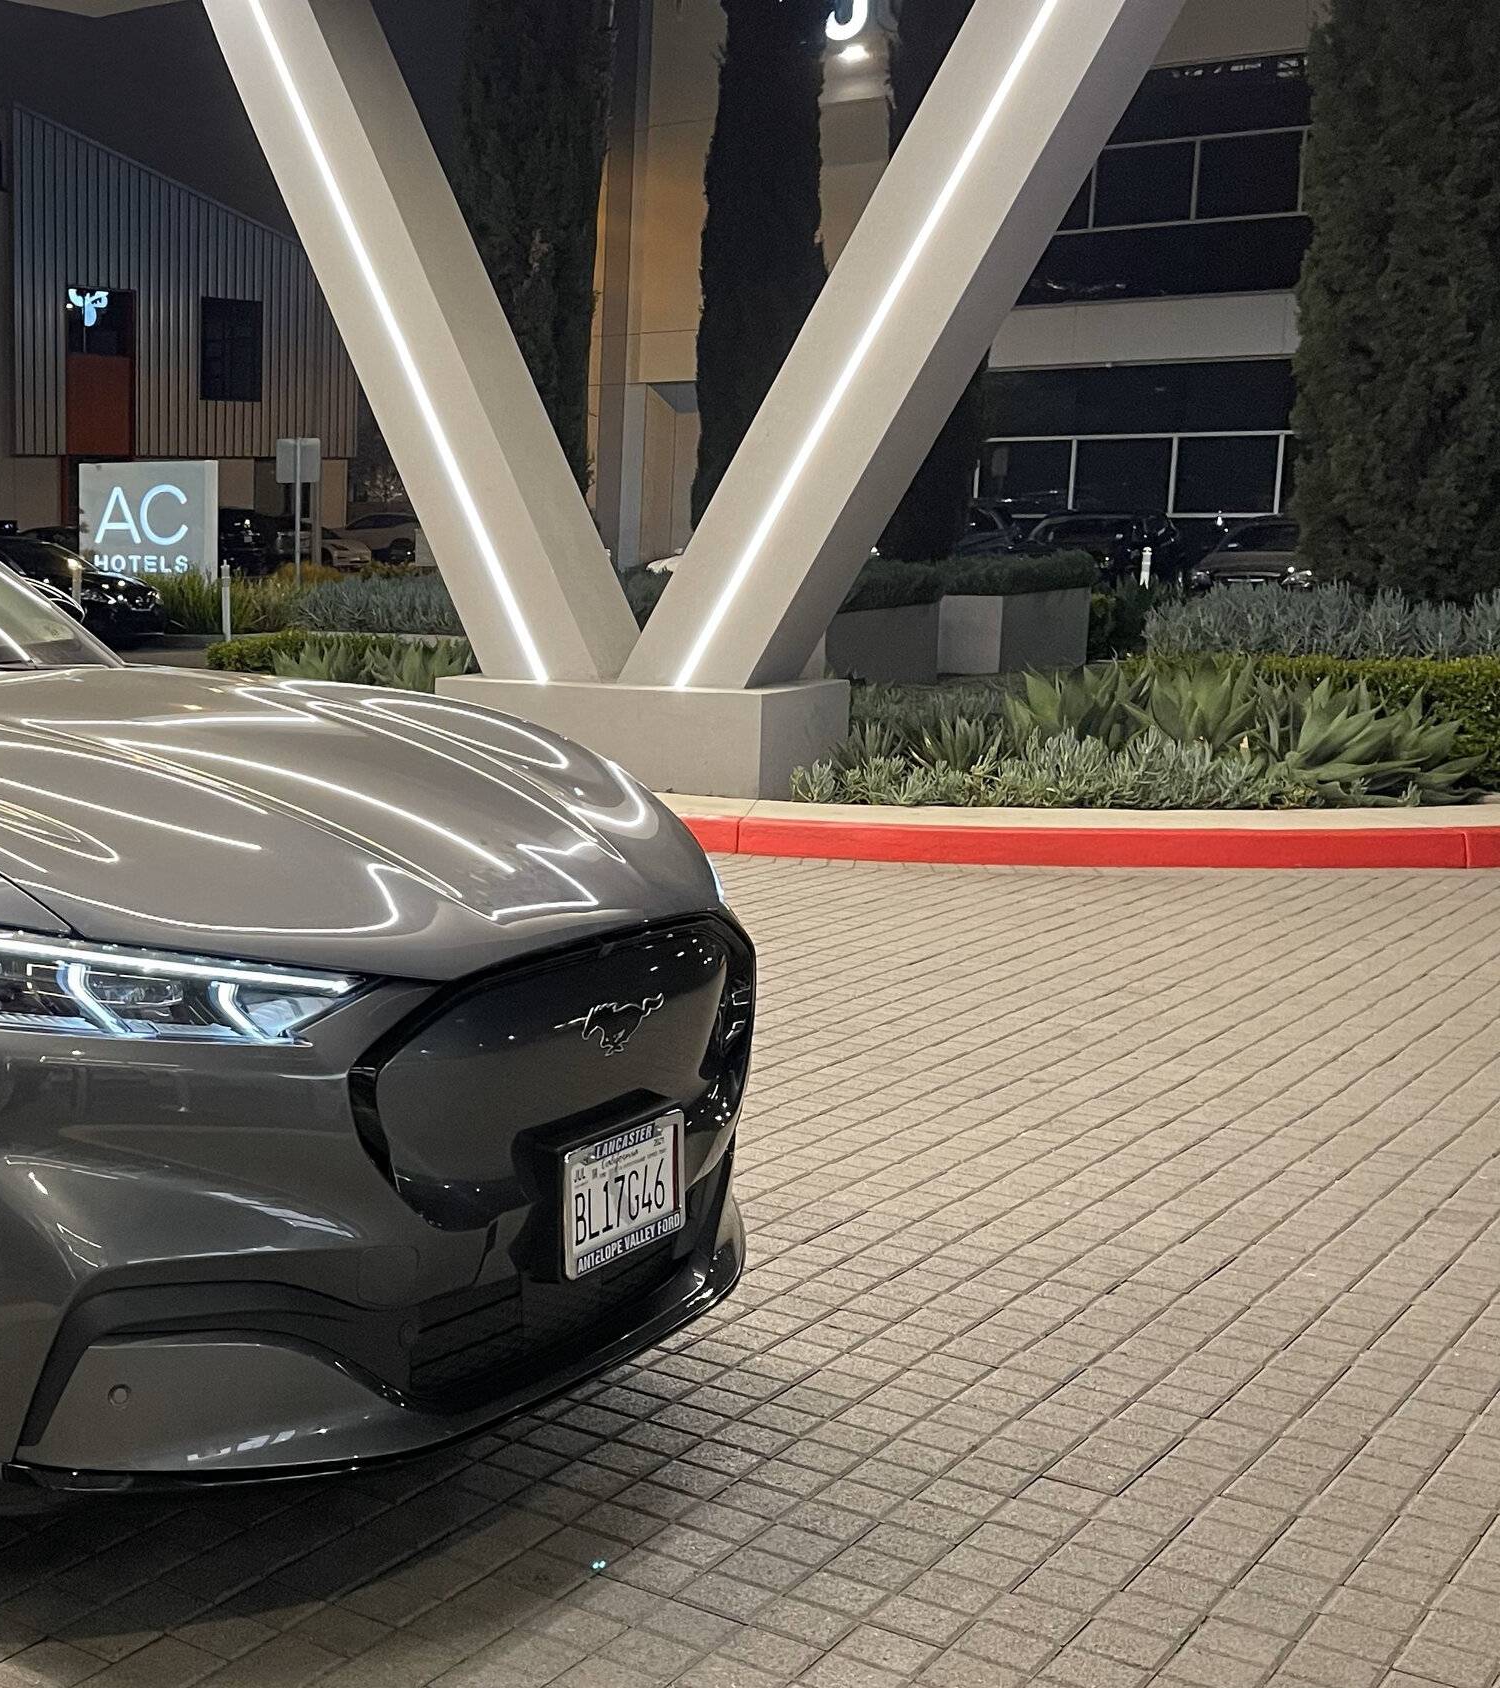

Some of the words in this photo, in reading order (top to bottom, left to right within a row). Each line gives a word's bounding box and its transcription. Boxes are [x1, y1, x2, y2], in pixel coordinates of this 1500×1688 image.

[94, 484, 189, 546] AC
[93, 554, 189, 573] HOTELS
[596, 1125, 653, 1159] LANCASTER
[575, 1158, 665, 1246] BL17G46
[578, 1239, 623, 1274] ANTELOPE
[624, 1226, 656, 1250] VALLEY
[657, 1213, 681, 1236] FORD
